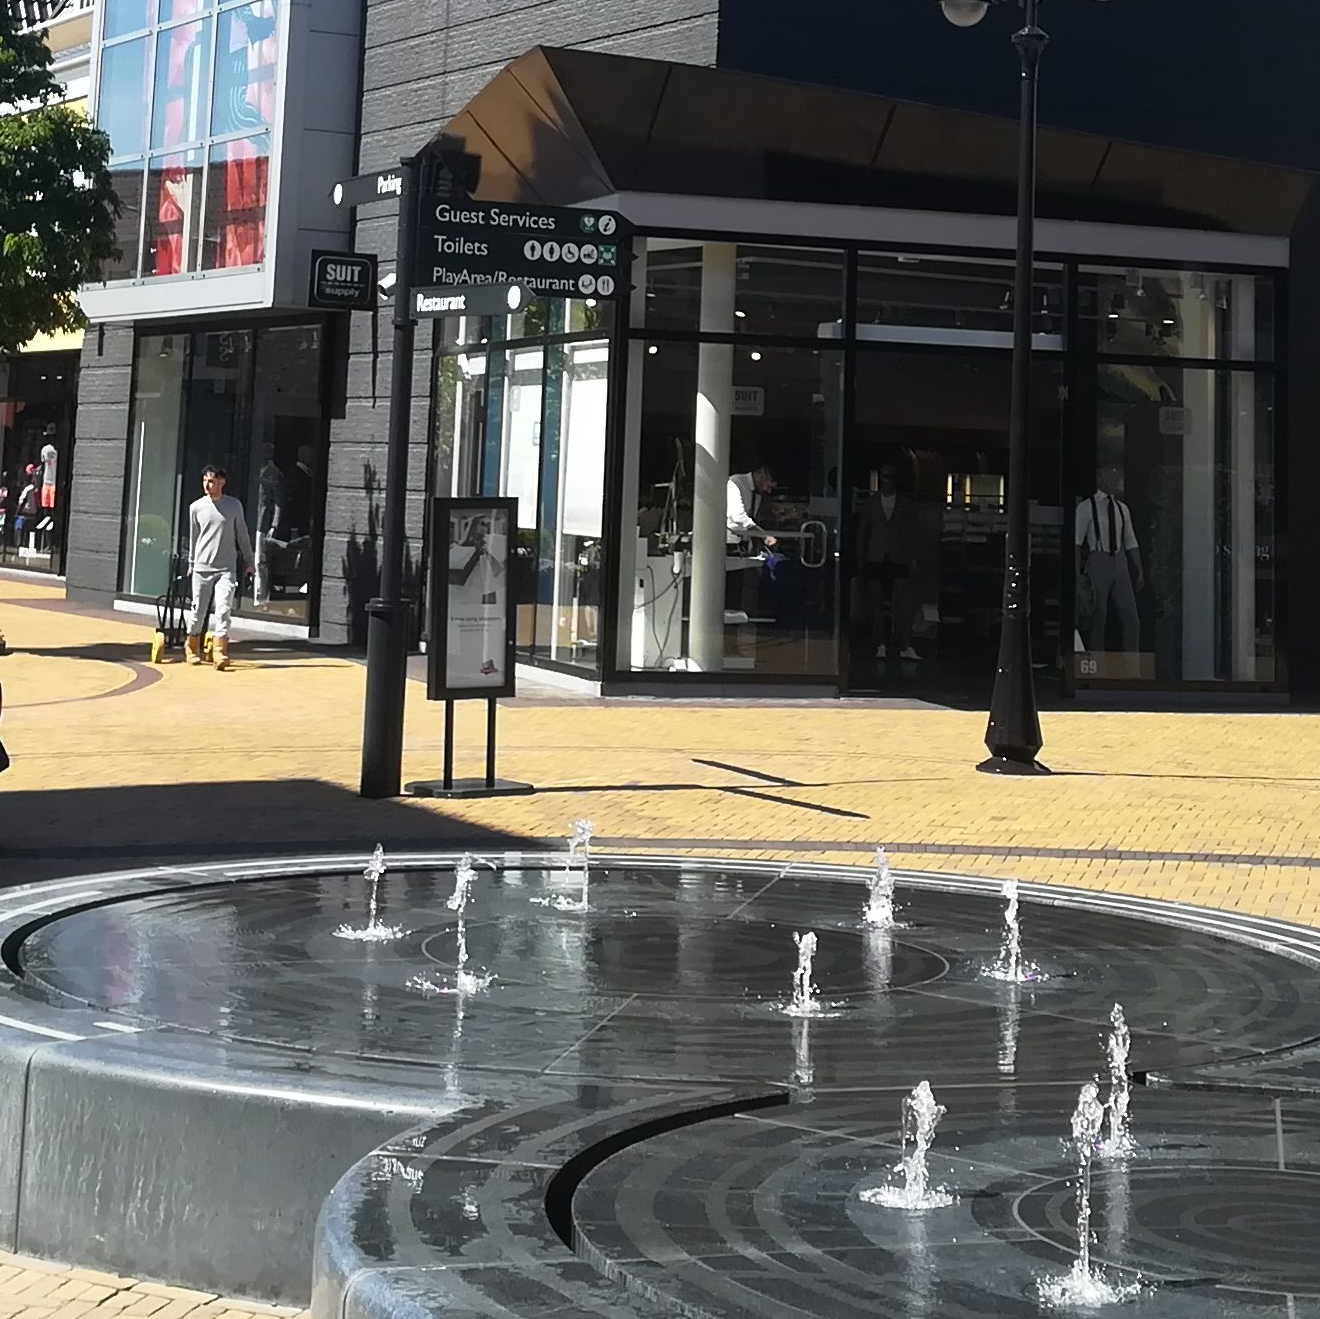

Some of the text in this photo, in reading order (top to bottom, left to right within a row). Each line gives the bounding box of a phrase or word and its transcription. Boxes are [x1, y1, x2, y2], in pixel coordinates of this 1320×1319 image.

[377, 174, 402, 195] Parking
[435, 204, 556, 230] Guest Services
[434, 234, 489, 256] Toilets
[326, 263, 361, 282] SUIT
[325, 286, 360, 298] supply
[416, 293, 466, 312] Restaurant
[1080, 659, 1098, 674] 69
